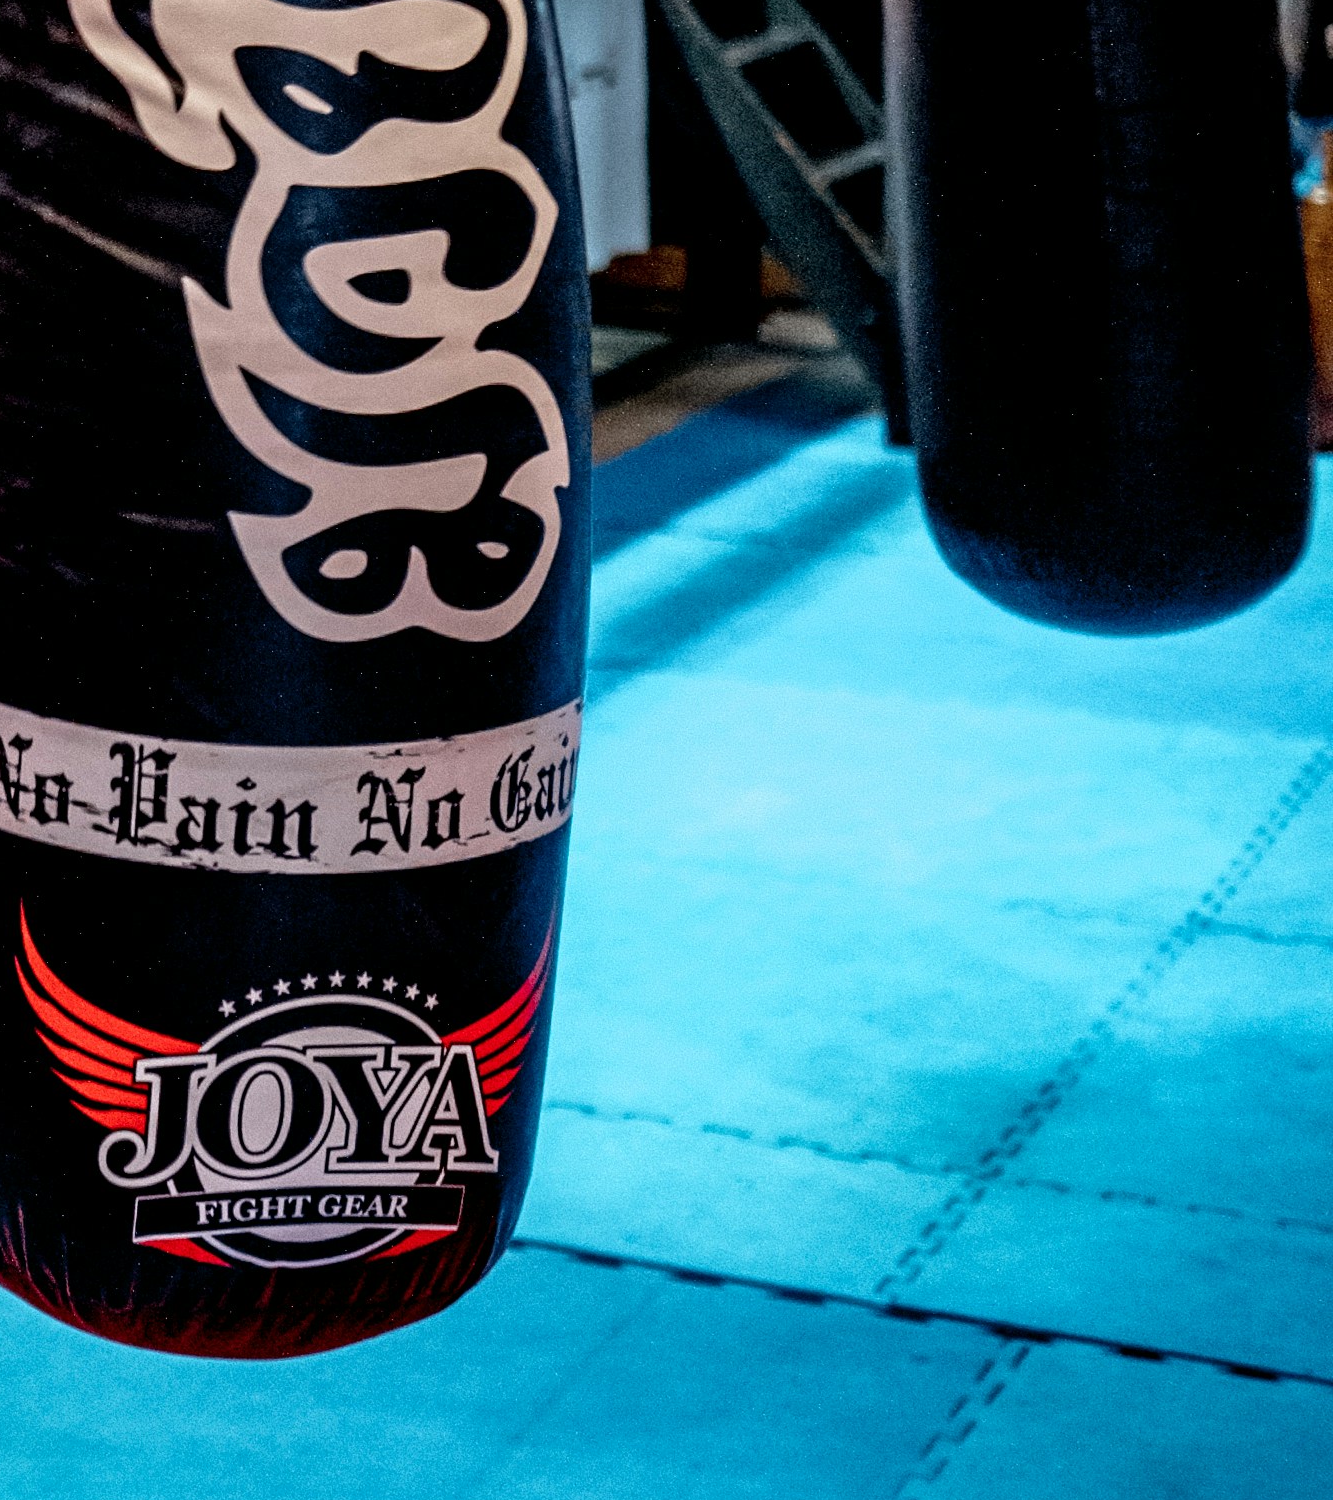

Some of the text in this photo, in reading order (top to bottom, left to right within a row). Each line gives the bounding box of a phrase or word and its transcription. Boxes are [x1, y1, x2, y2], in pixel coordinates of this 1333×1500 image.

[108, 742, 319, 858] Pain
[349, 765, 465, 855] No
[98, 1045, 499, 1187] JOYA
[195, 1192, 409, 1226] FIGHT GEAR
